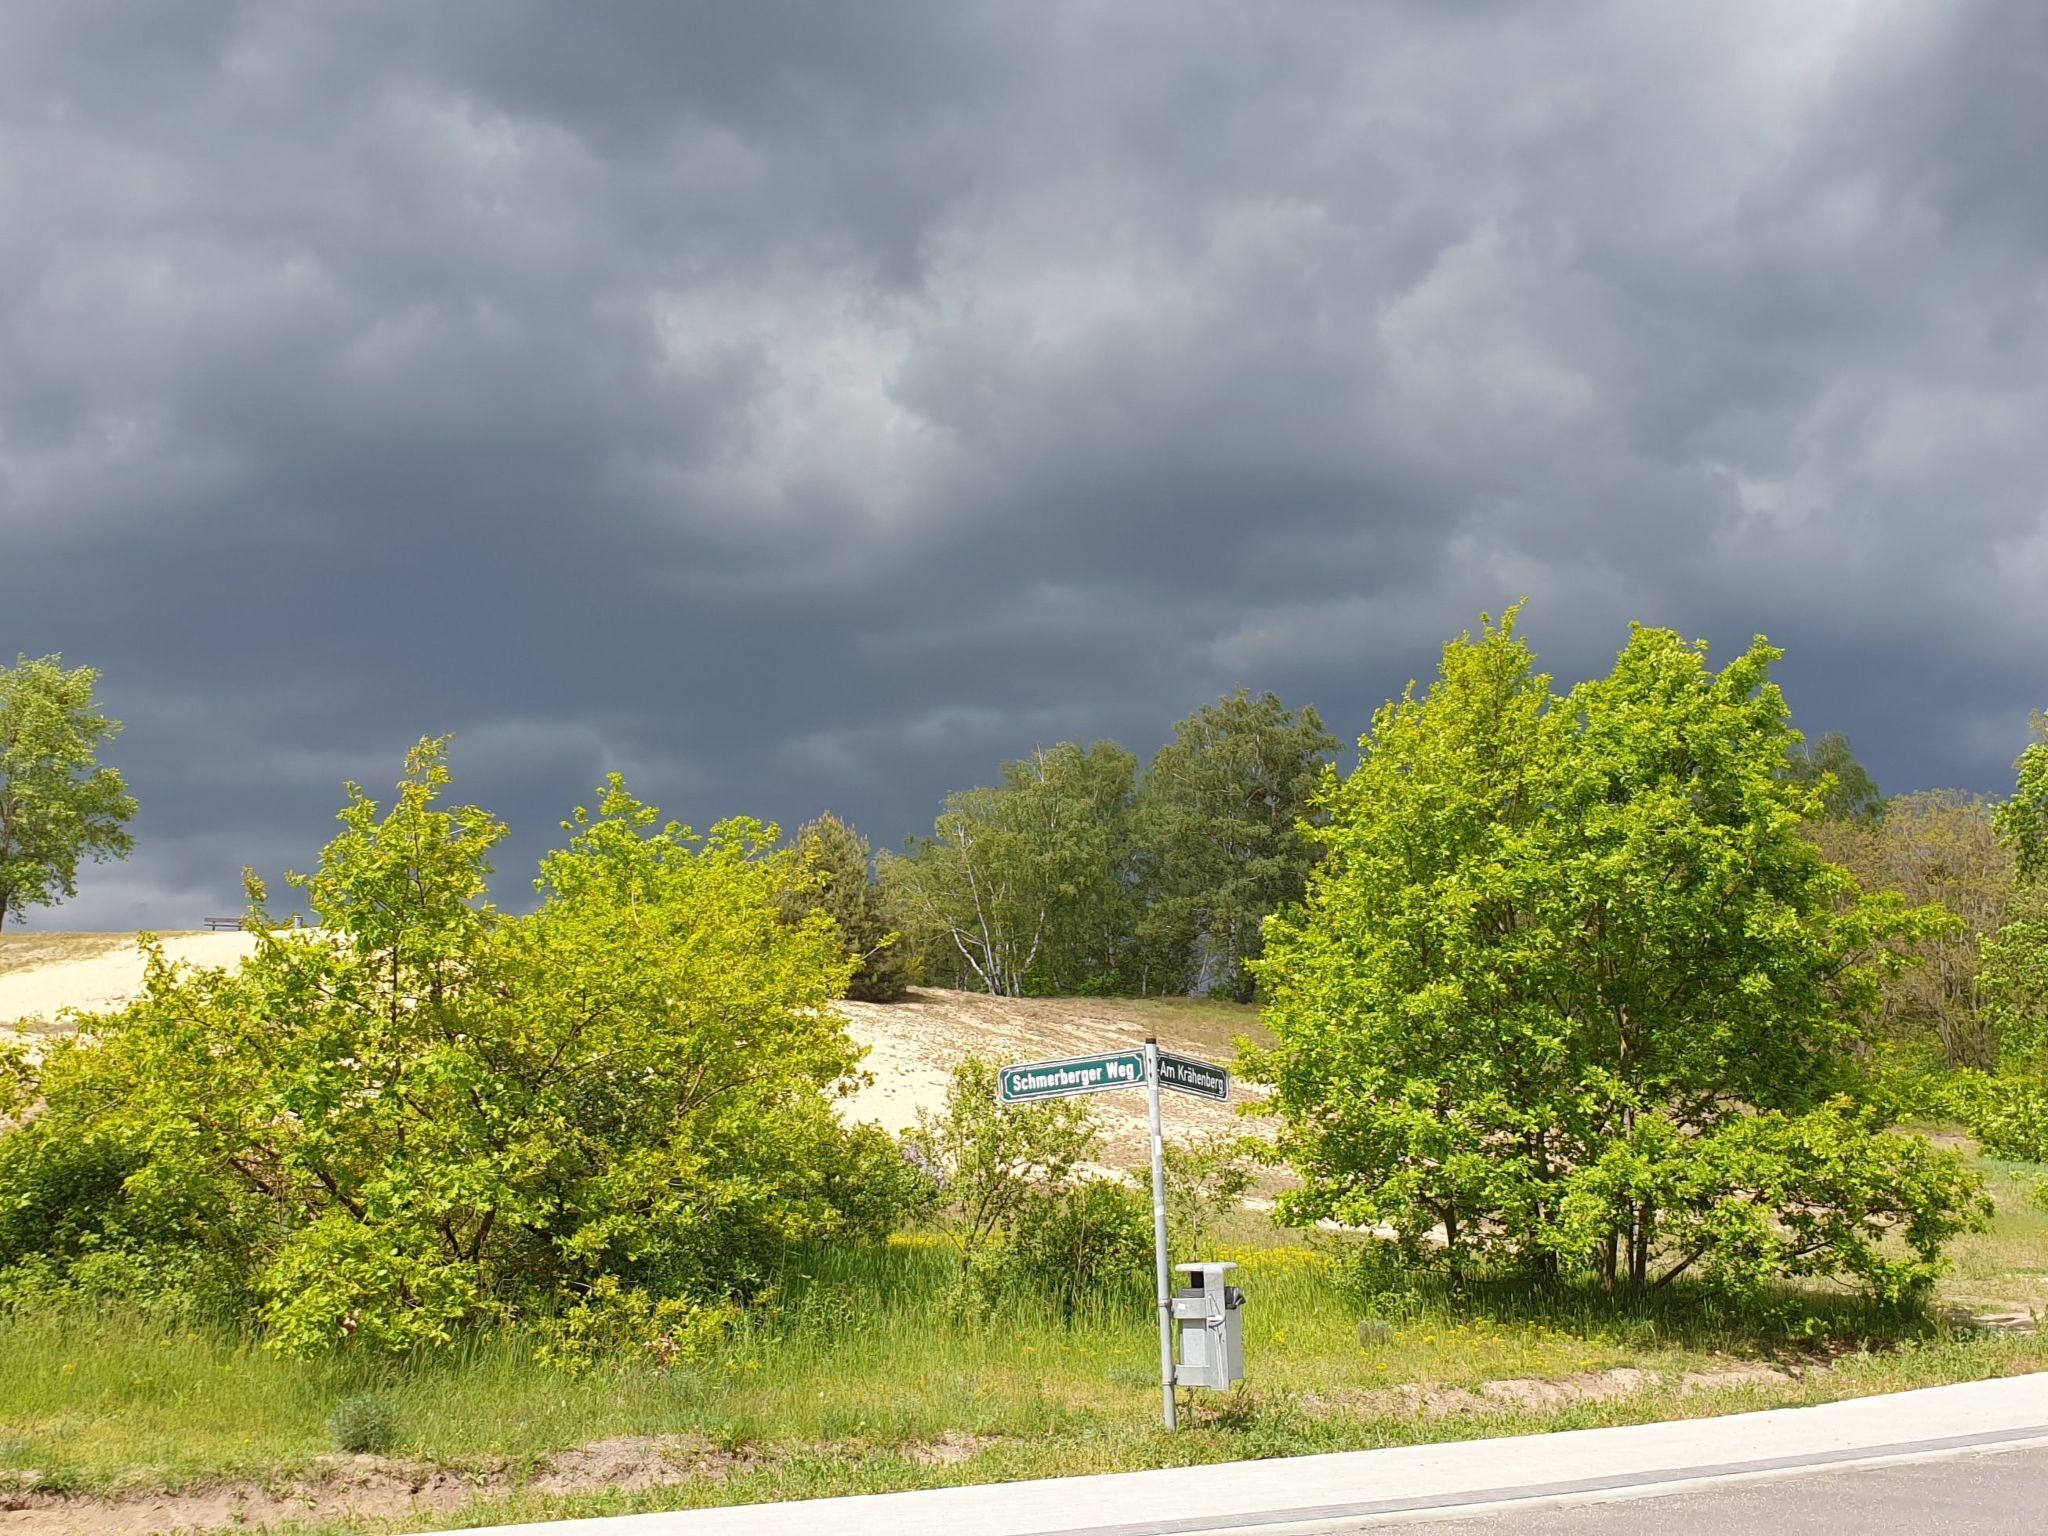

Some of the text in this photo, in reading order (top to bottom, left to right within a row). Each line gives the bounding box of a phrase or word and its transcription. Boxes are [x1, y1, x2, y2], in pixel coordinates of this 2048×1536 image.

[1013, 1061, 1134, 1091] Schmerberger Weg
[1160, 1061, 1224, 1092] Am Krähenberg
